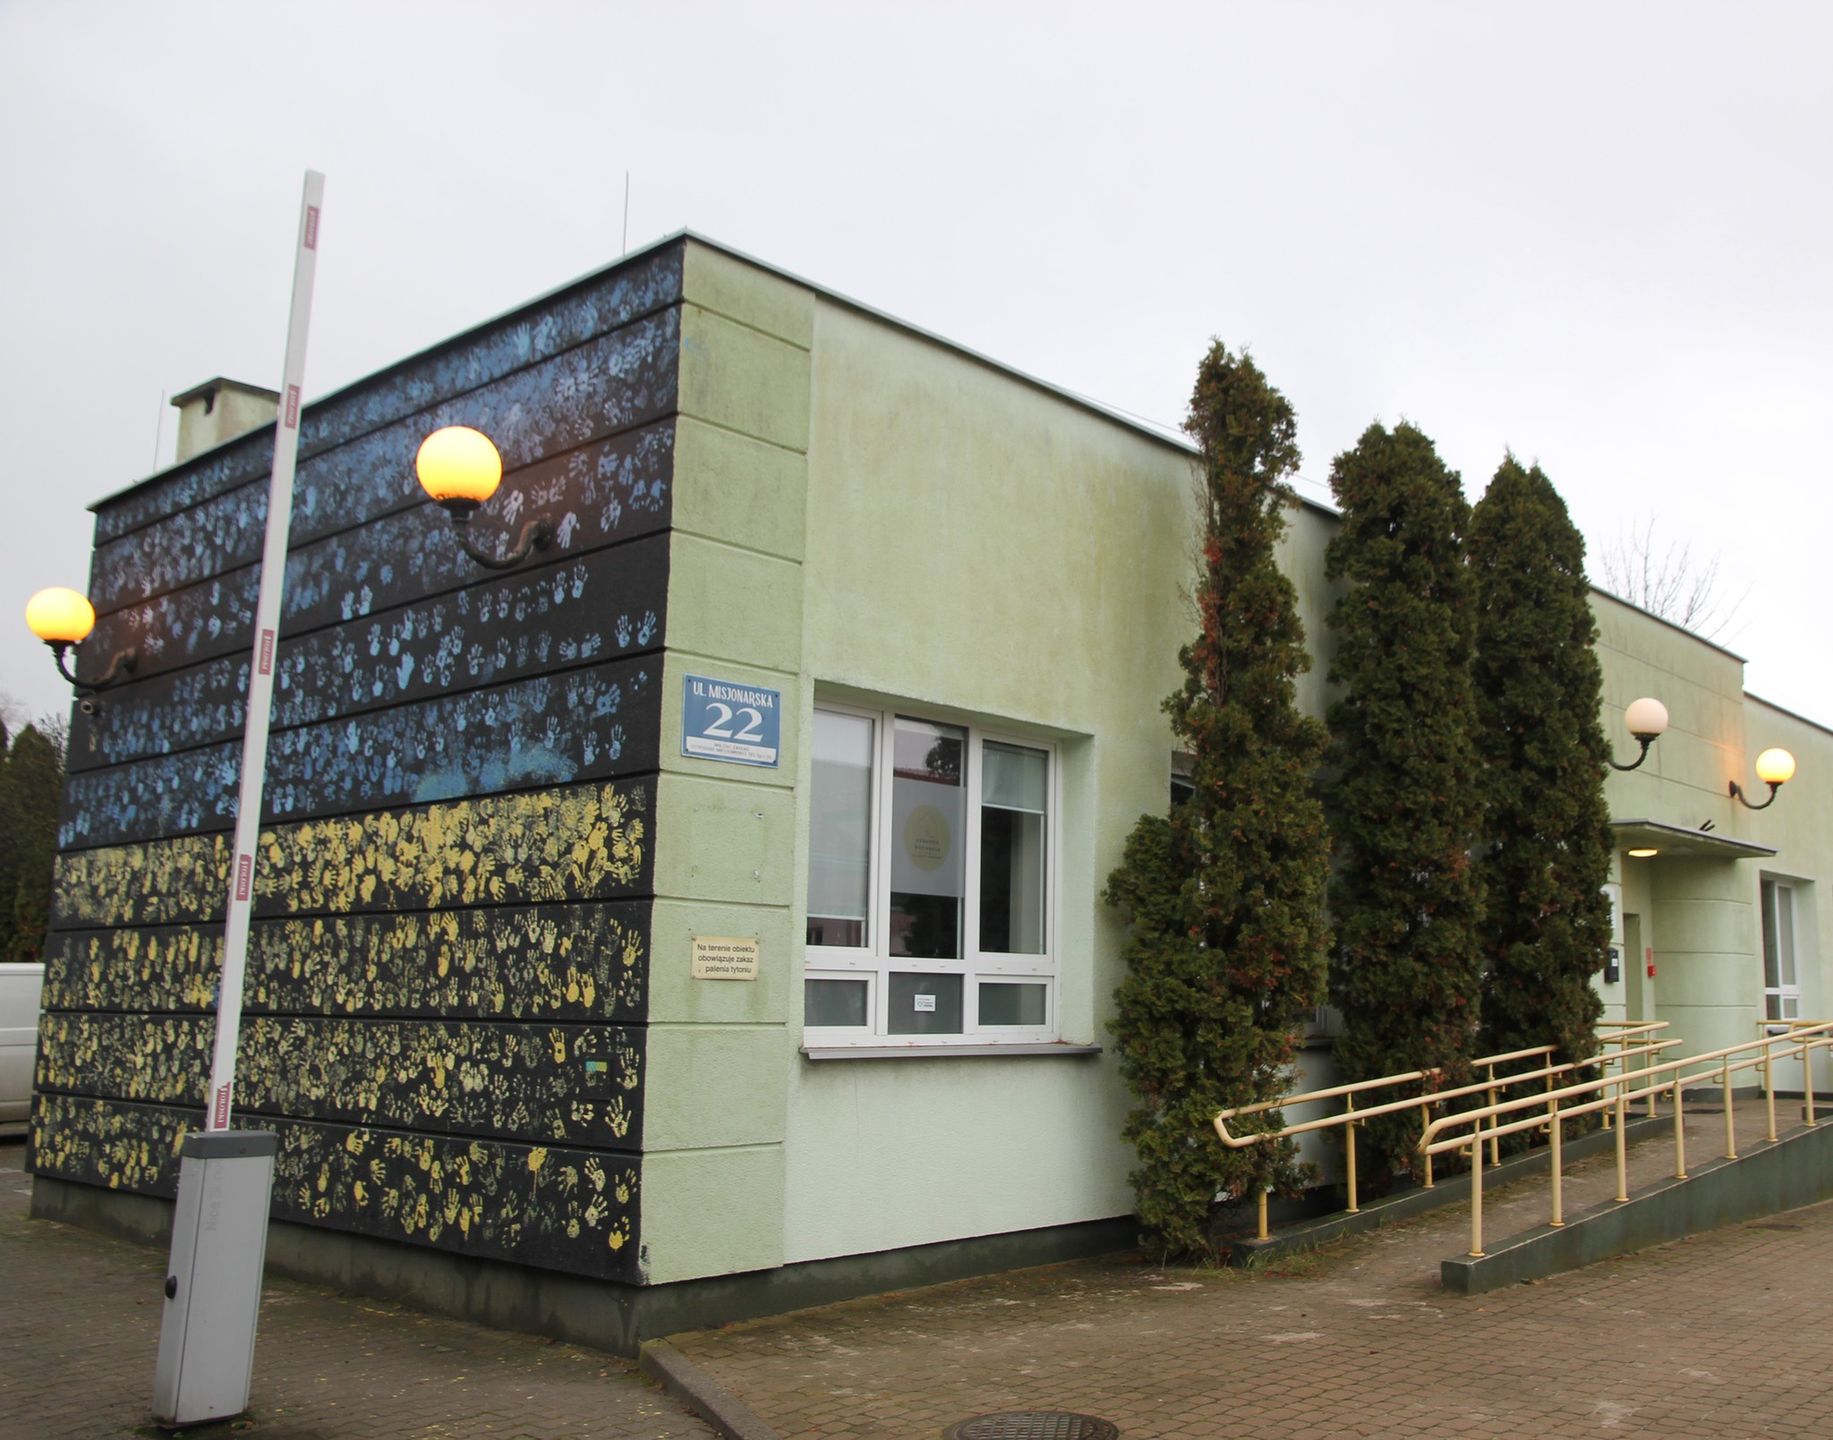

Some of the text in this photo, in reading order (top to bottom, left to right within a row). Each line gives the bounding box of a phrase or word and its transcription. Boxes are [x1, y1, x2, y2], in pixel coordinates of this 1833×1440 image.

[693, 681, 773, 708] UL. MISJONARSKA
[703, 702, 763, 742] 22
[708, 944, 730, 952] terenie
[732, 945, 755, 953] obiektu
[698, 954, 735, 963] obowiązuje
[705, 965, 752, 974] palenia tytoniu
